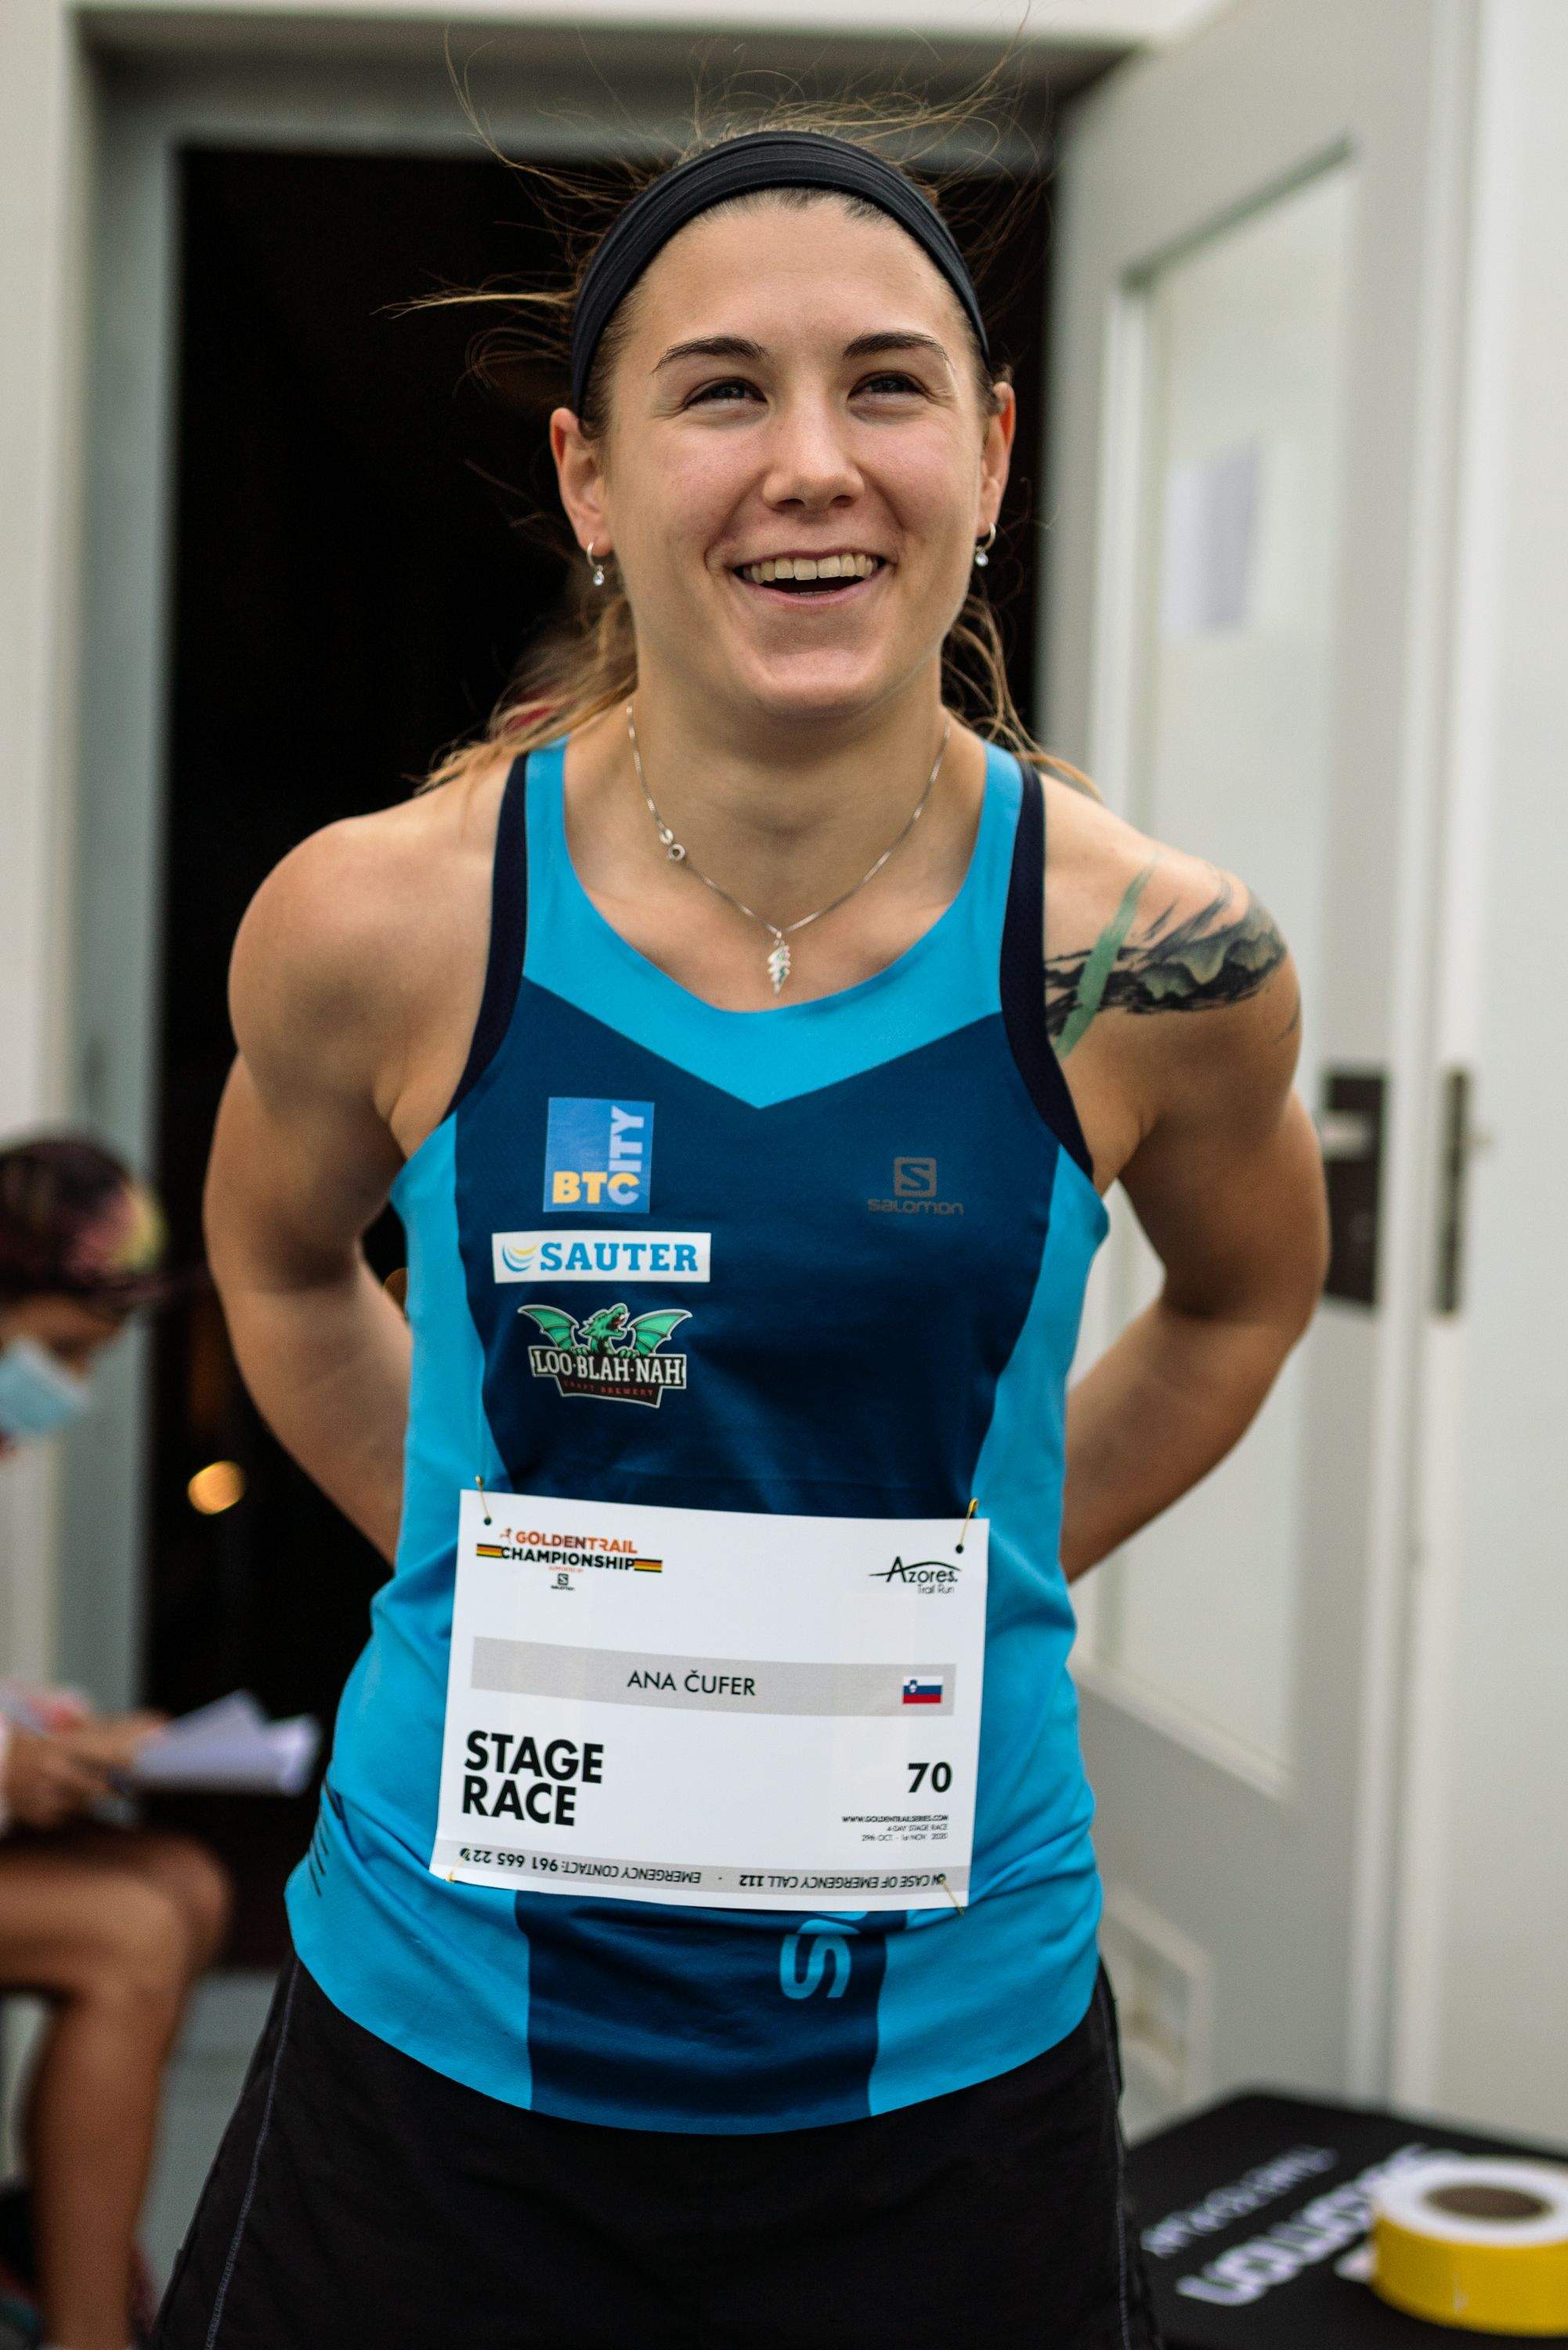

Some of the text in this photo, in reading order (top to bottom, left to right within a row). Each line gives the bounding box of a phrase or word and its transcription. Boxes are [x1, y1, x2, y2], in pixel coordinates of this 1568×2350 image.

[552, 1170, 641, 1206] BTC
[540, 1242, 698, 1271] SAUTER
[515, 1531, 638, 1553] GOLDENTRAIL
[501, 1546, 636, 1571] CHAMPIONSHIP
[938, 1584, 955, 1594] Run
[627, 1670, 756, 1696] ANA ČUFER
[464, 1730, 604, 1784] STAGE
[908, 1761, 952, 1794] 70
[461, 1774, 576, 1826] RACE
[497, 1852, 526, 1870] 665
[531, 1855, 558, 1873] 961
[561, 1862, 620, 1878] CONTACT:
[622, 1867, 702, 1884] EMERGENCY
[739, 1875, 764, 1887] 112
[768, 1875, 799, 1889] CALL
[801, 1876, 880, 1889] EMERGENCY
[880, 1876, 898, 1889] OF
[899, 1875, 931, 1888] CASE
